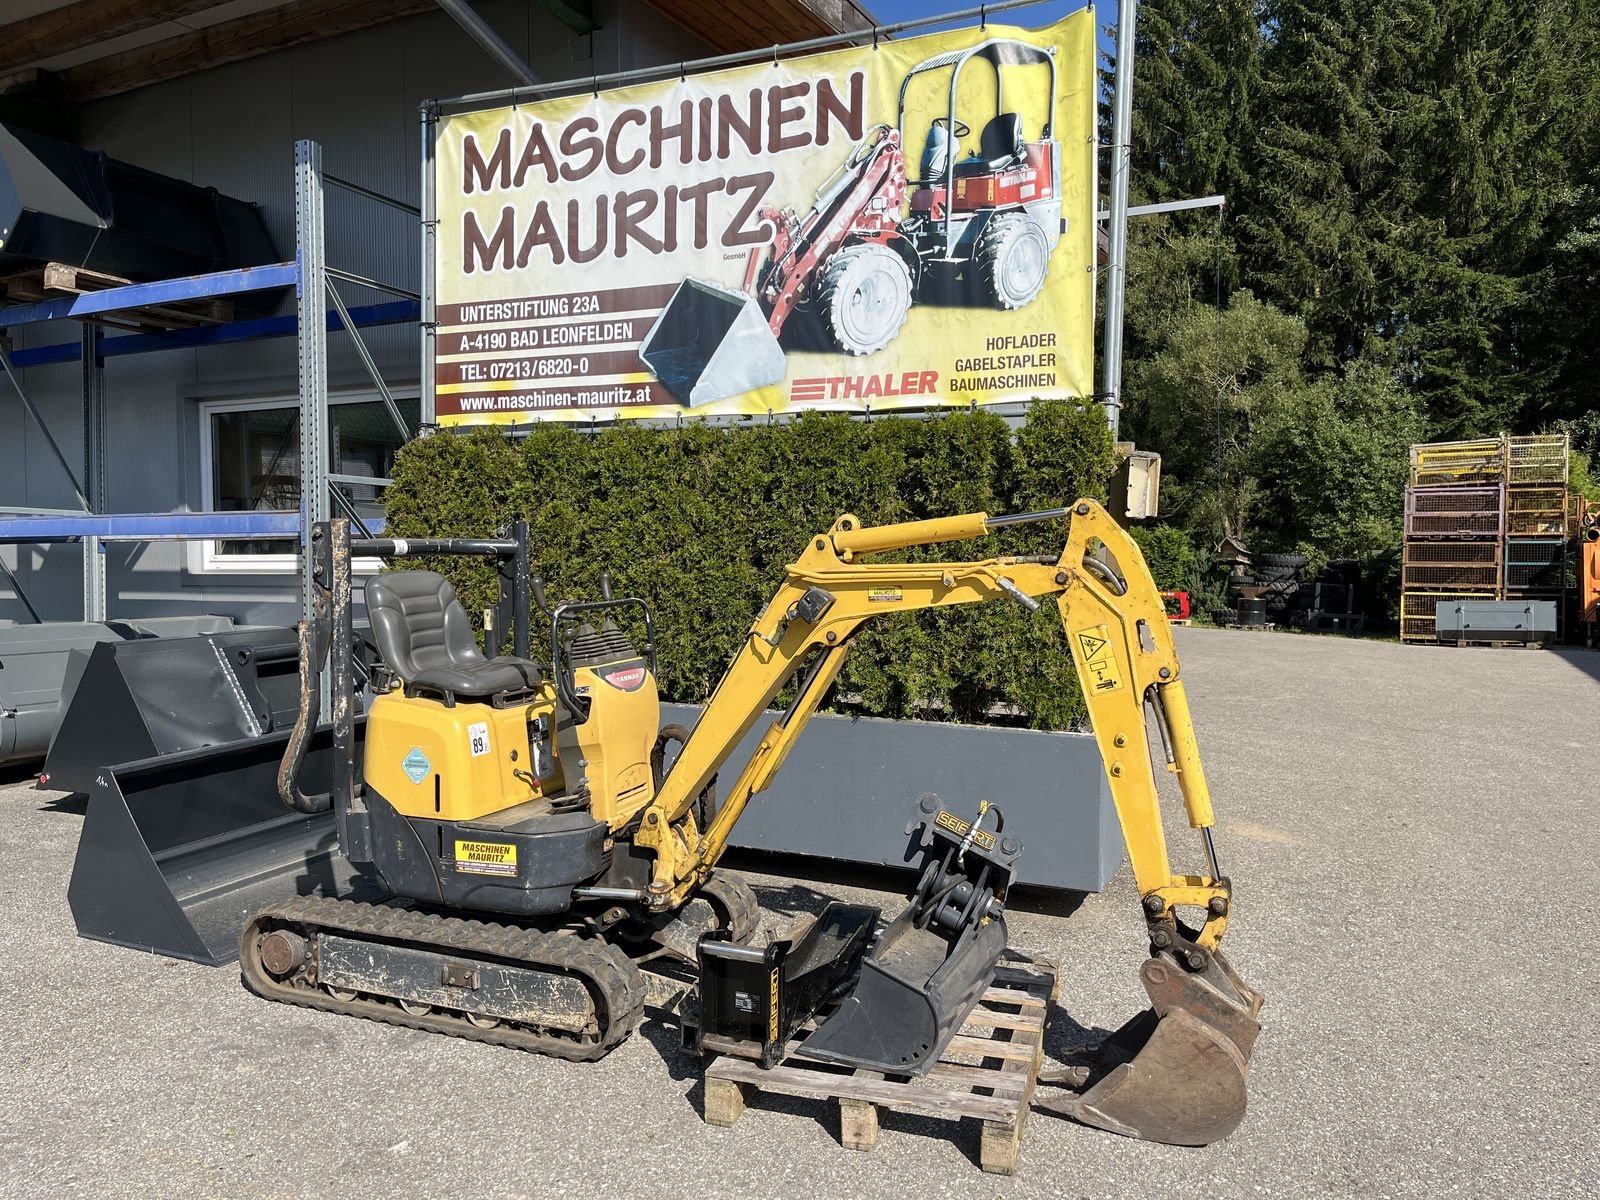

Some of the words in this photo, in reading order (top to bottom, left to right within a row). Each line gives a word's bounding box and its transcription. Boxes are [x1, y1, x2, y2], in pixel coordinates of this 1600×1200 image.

[463, 72, 864, 194] MASCHINEN
[463, 171, 775, 274] MAURITZ
[723, 252, 746, 261] GesmbH
[460, 297, 569, 323] UNTERSTIFTUNG
[572, 295, 600, 313] 23A
[460, 334, 507, 351] A-4190
[510, 329, 538, 348] BAD
[543, 322, 633, 345] LEONFELDEN
[986, 333, 1056, 351] HOFLADER
[460, 364, 487, 381] TEL:
[490, 357, 589, 379] 07213/6820-0
[955, 353, 1056, 373] GABELSTAPLER
[824, 370, 939, 399] THALER
[950, 373, 1056, 392] BAUMASCHINEN
[460, 386, 651, 411] www.maschinen-mauritz.at
[616, 673, 640, 682] YANMAR
[473, 737, 484, 753] 89
[939, 813, 993, 847] SEIFRT
[462, 843, 510, 855] MASCHINEN
[468, 853, 505, 863] MAURITZ
